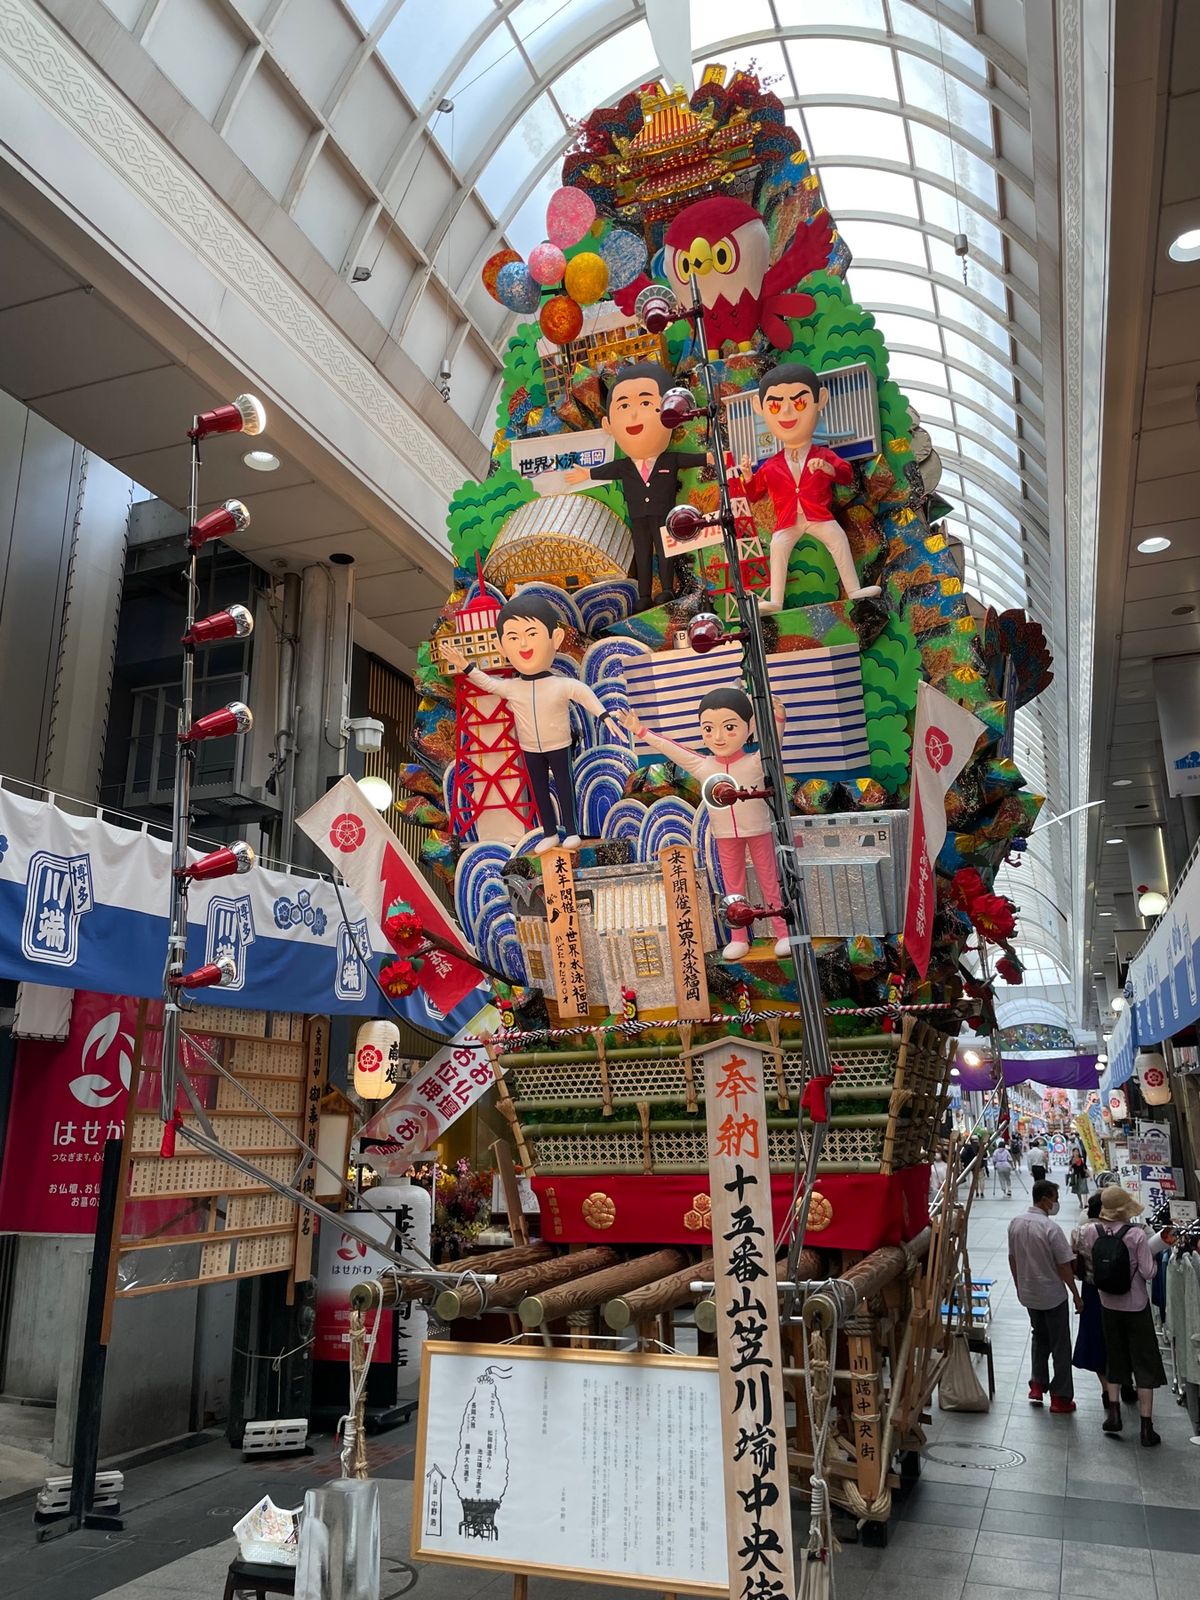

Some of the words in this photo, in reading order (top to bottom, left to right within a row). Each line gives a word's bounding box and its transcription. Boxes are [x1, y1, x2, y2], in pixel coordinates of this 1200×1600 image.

[878, 831, 887, 841] B
[37, 868, 71, 951] 川端
[70, 864, 89, 909] 博多
[237, 903, 251, 942] 博多
[417, 1046, 476, 1102] お位牌
[438, 1062, 494, 1121] お仏壇
[714, 1054, 759, 1160] 奉納
[331, 1265, 373, 1275] はせがわ
[853, 1358, 875, 1461] 川端中央街
